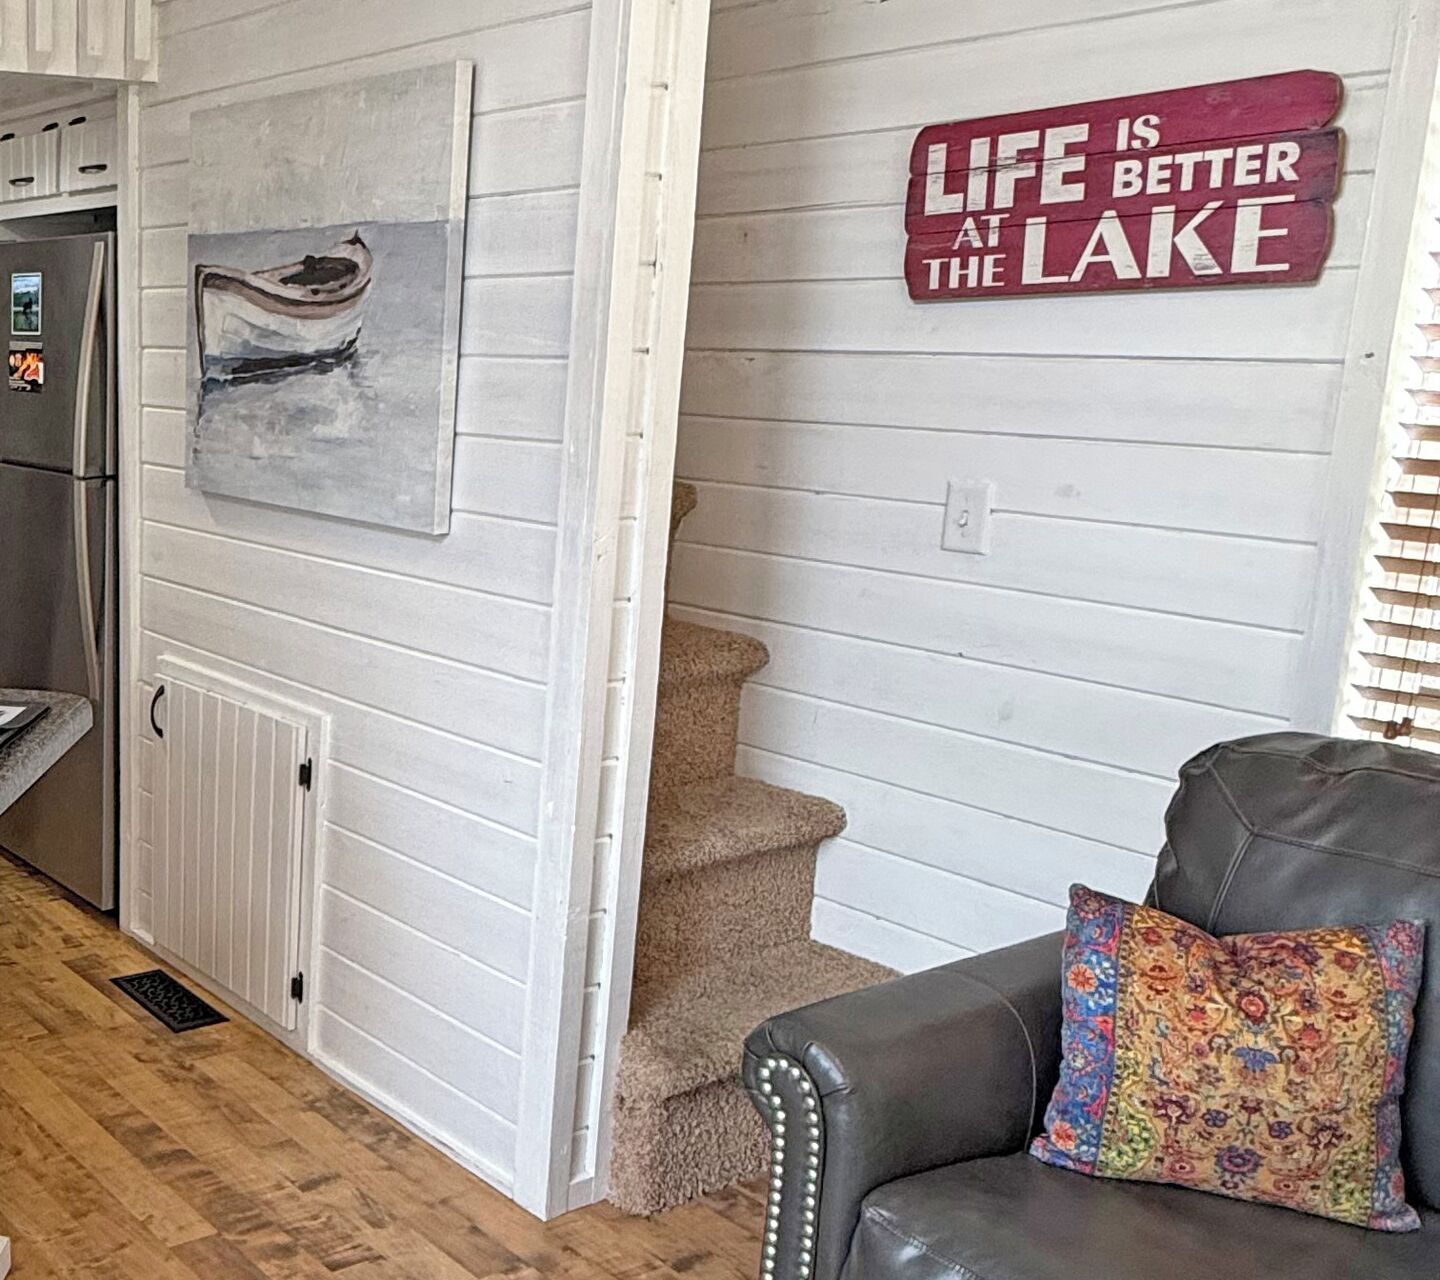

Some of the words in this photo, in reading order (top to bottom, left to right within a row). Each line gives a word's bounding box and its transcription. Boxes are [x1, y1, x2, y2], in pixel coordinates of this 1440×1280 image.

[923, 123, 1089, 217] LIFE
[1115, 114, 1160, 152] IS
[1111, 141, 1301, 198] BETTER
[921, 254, 1006, 290] THE
[1021, 194, 1296, 286] LAKE
[952, 213, 1010, 250] AT
